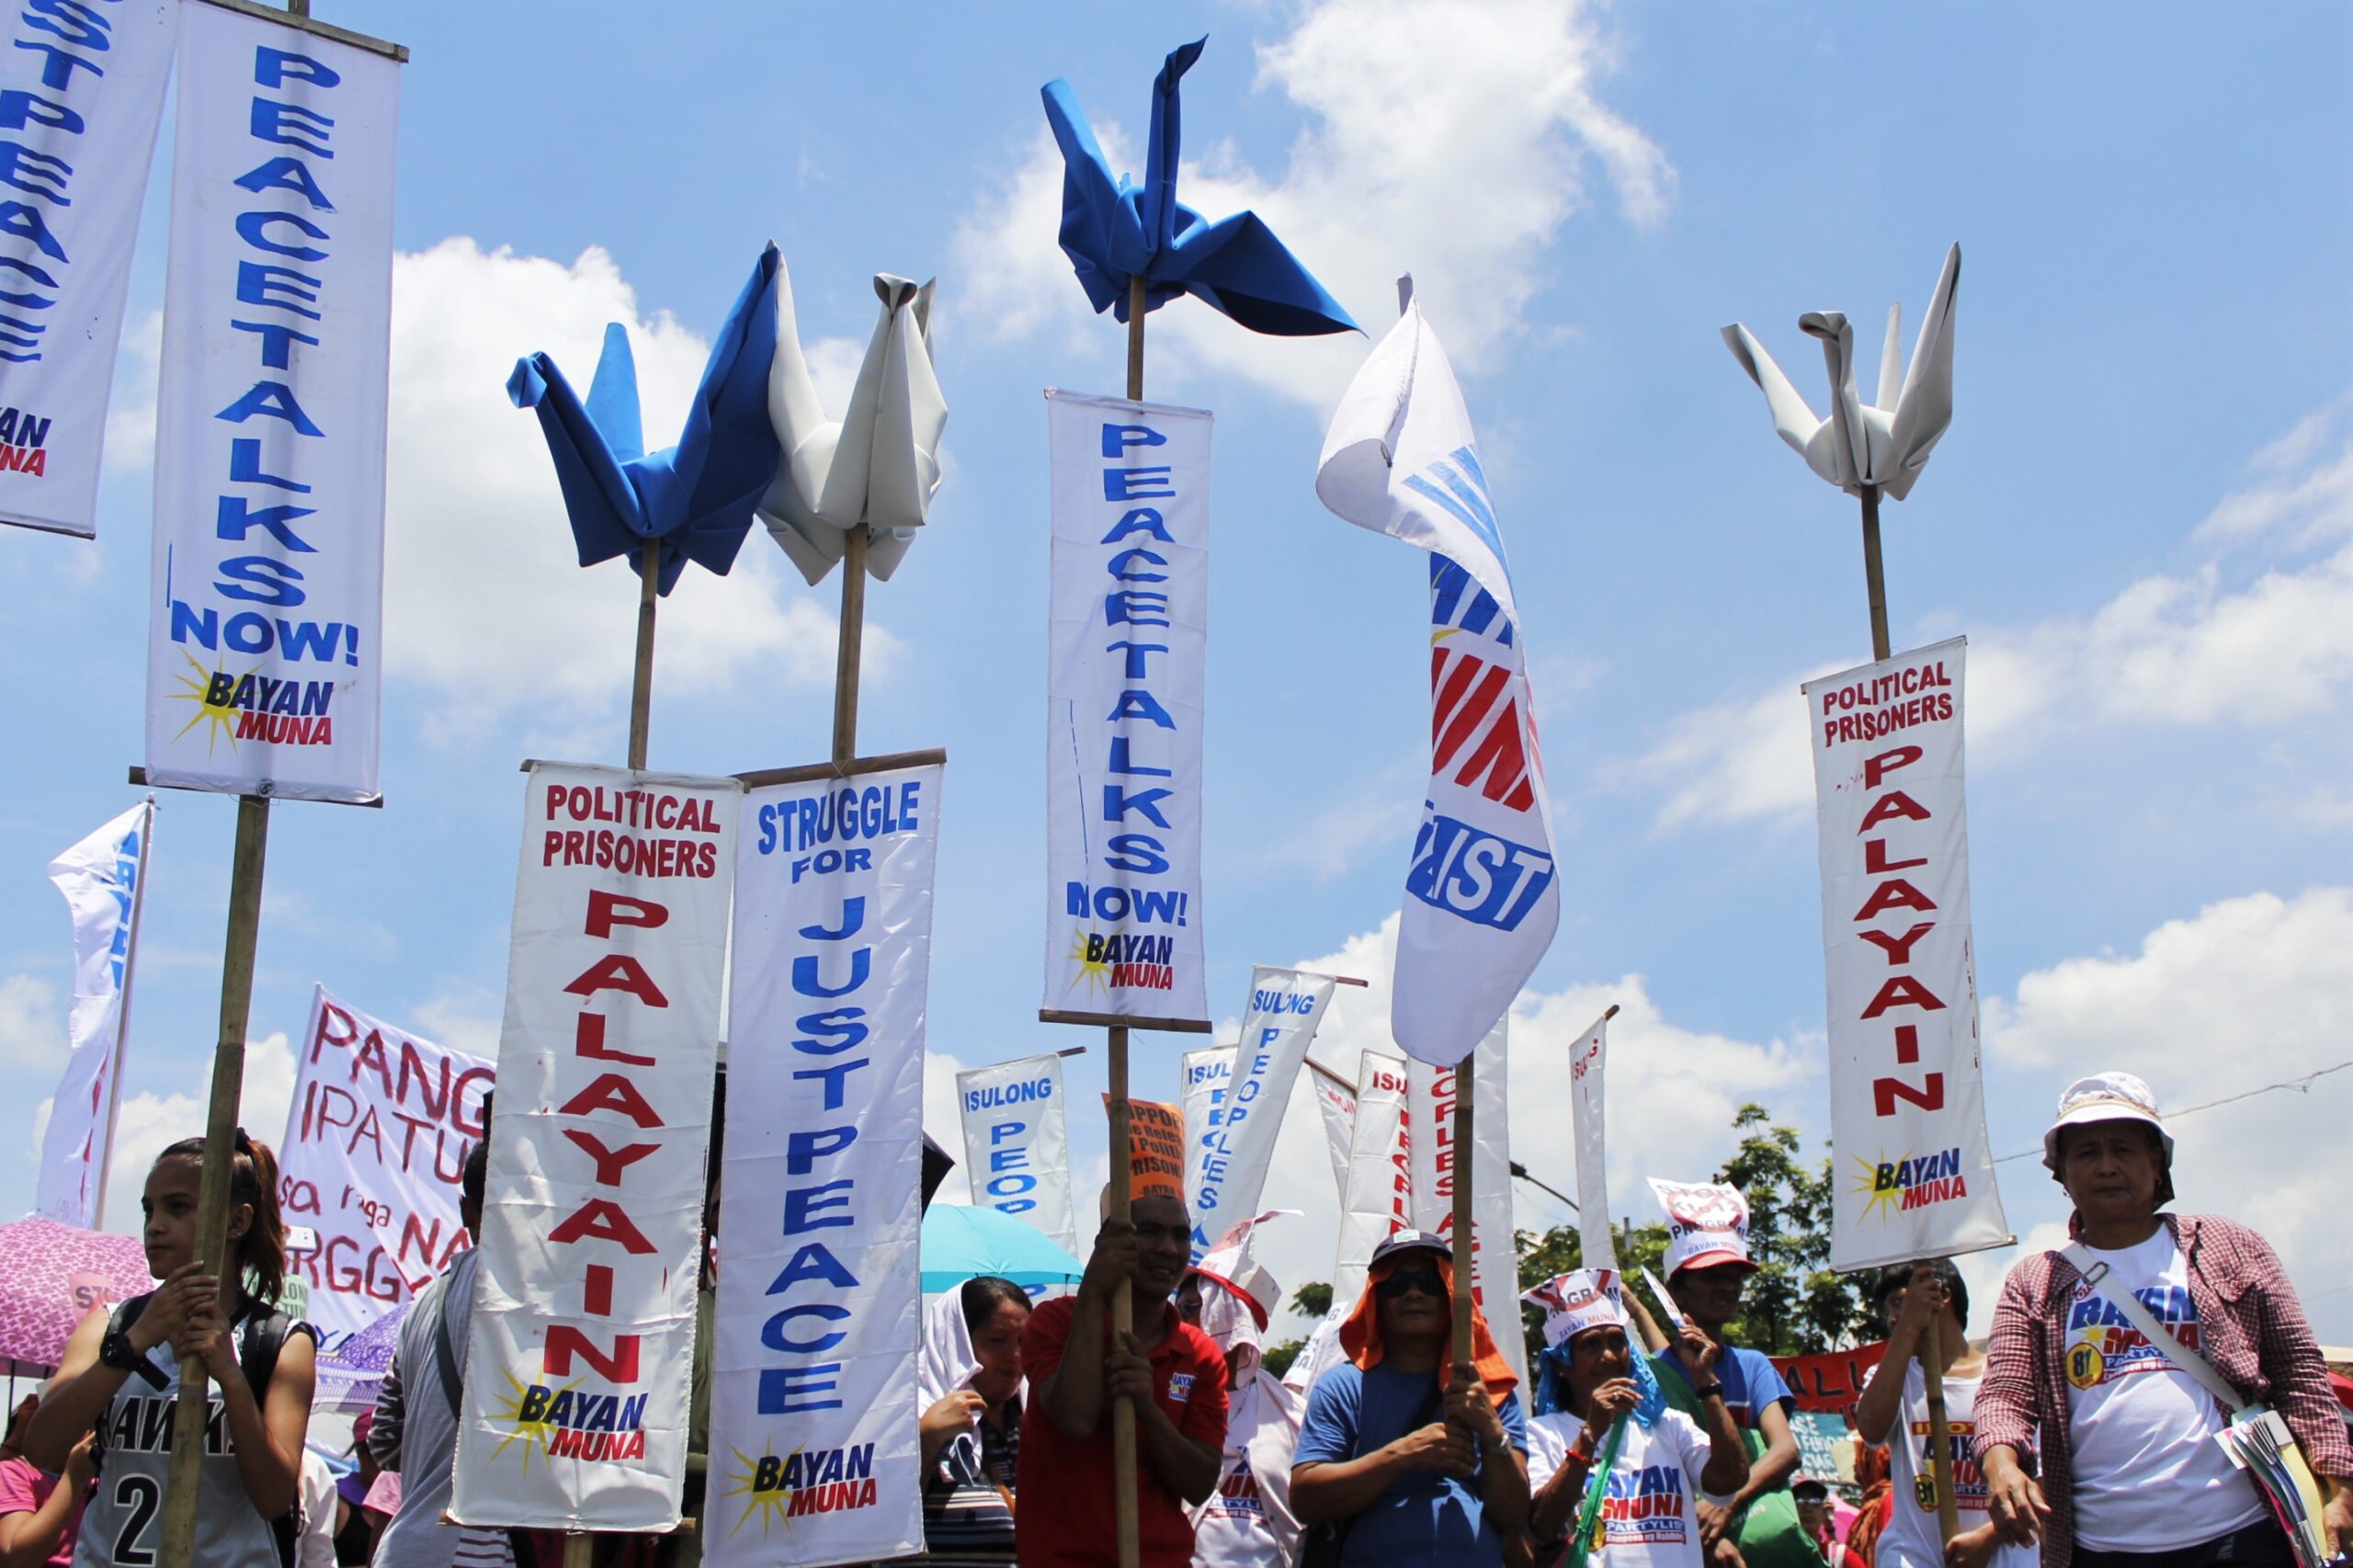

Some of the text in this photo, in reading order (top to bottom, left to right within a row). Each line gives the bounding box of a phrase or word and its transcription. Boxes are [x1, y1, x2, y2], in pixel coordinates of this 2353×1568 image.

[0, 405, 51, 449] AN
[0, 442, 46, 477] NA
[171, 599, 358, 666] NOW!
[205, 671, 334, 716] BAYAN
[1823, 661, 1951, 716] POLITICAL
[235, 710, 332, 745] MUNA
[1824, 692, 1952, 747] PRISONERS
[546, 785, 721, 834] POLITICAL
[758, 781, 920, 855] STRUGGLE
[543, 830, 717, 879] PRISONERS
[792, 847, 872, 884] FOR
[1067, 881, 1188, 926] NOW!
[1086, 933, 1173, 965] BAYAN
[1853, 745, 1948, 1117] PALAYAIN
[1109, 962, 1173, 990] MUNA
[965, 1078, 1051, 1112] ISULONG
[1188, 1062, 1232, 1085] ISUL
[1372, 1070, 1409, 1095] ISU
[543, 890, 668, 1383] PALAYAIN
[986, 1122, 1037, 1214] PEOP
[1875, 1148, 1960, 1191] BAYAN
[1901, 1176, 1967, 1210] MUNA
[518, 1385, 648, 1432] BAYAN
[548, 1429, 644, 1462] MUNA
[753, 1442, 874, 1493] BAYAN
[787, 1478, 876, 1517] MUNA
[1606, 1521, 1683, 1532] PARTYLIS
